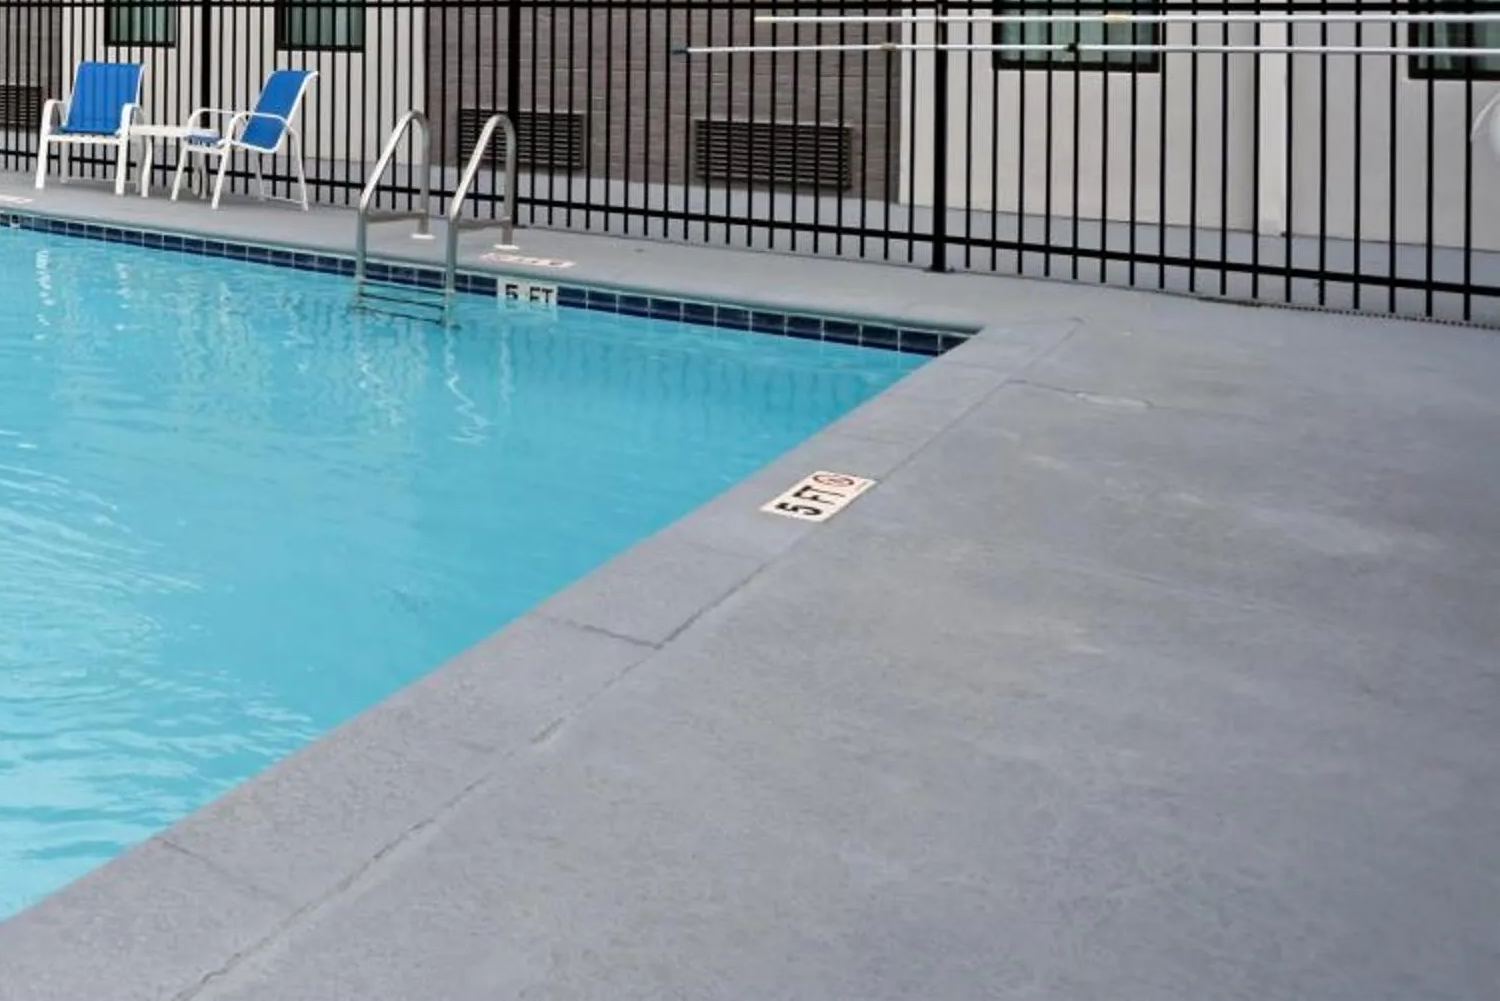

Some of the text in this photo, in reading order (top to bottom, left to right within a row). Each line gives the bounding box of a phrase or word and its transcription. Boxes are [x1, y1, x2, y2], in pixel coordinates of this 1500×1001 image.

[505, 283, 554, 303] 5 FT
[792, 484, 846, 506] FT
[775, 502, 824, 516] 5
